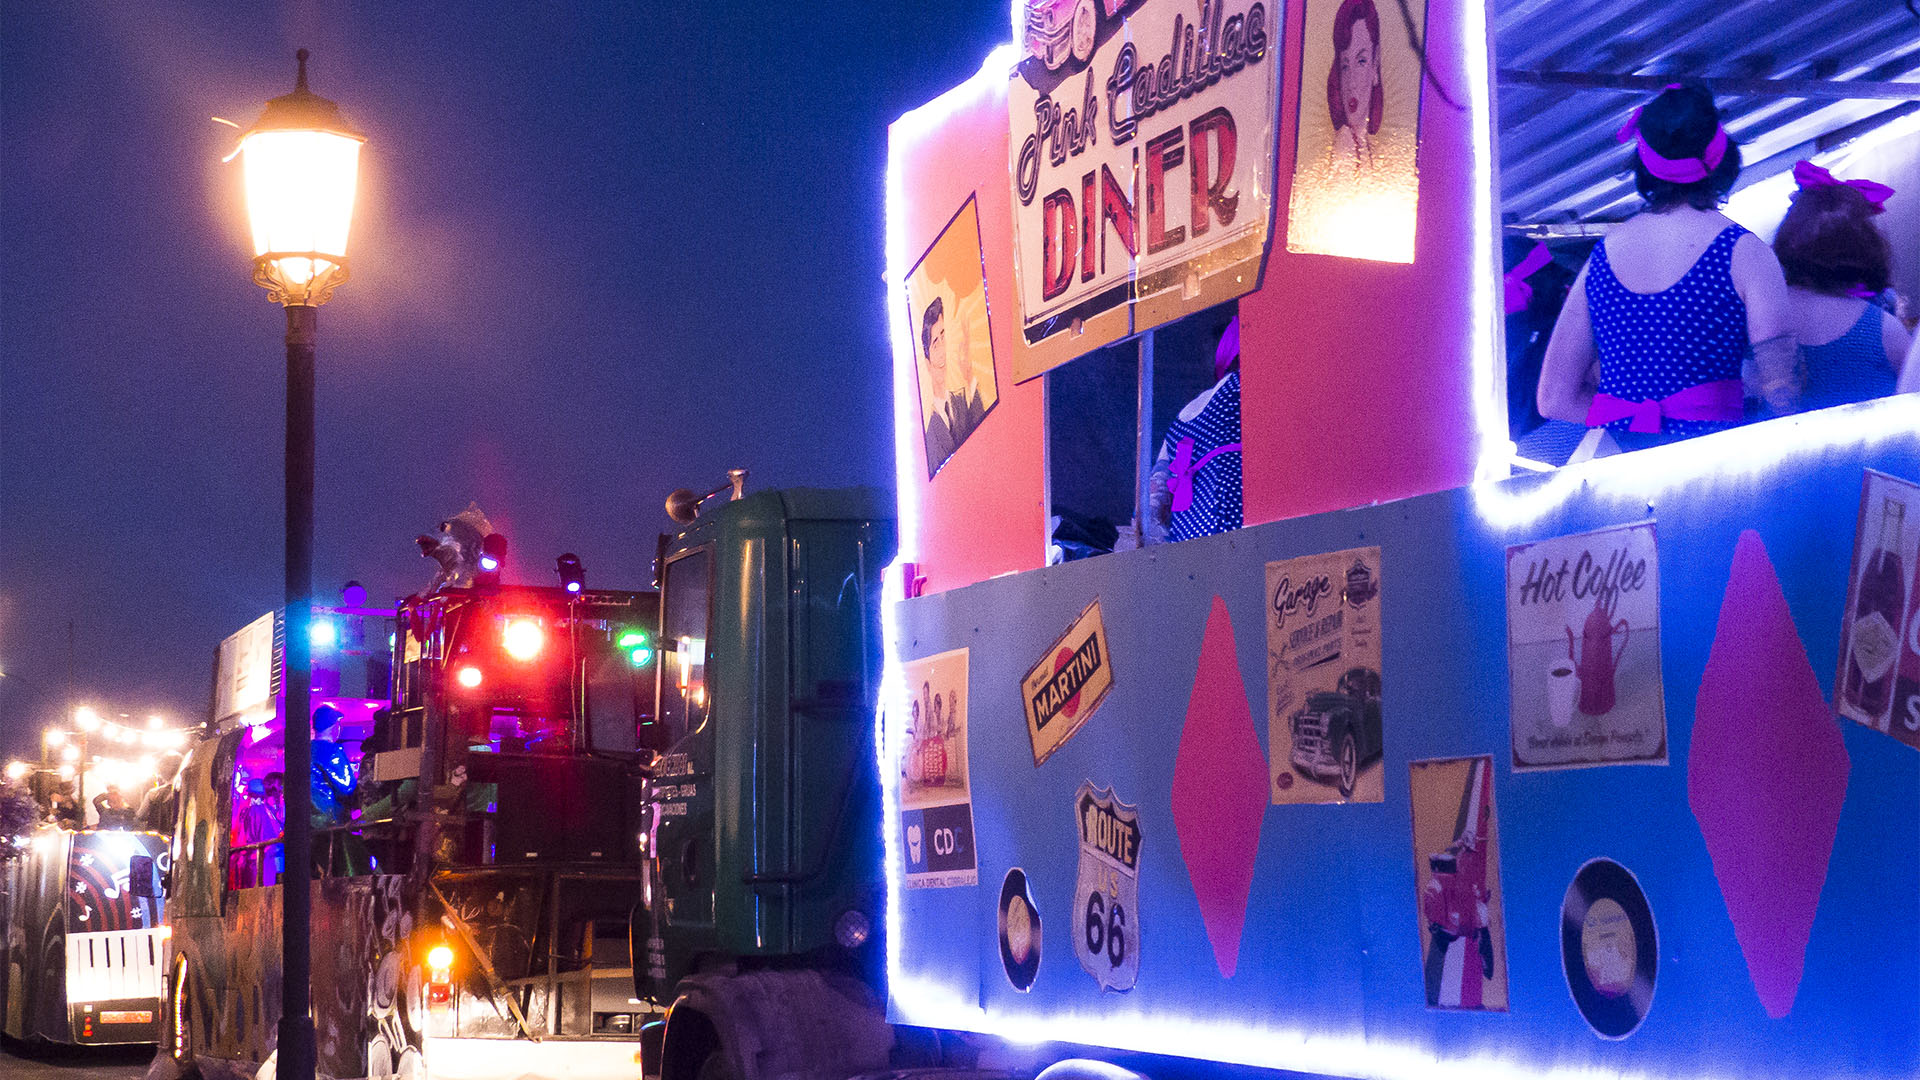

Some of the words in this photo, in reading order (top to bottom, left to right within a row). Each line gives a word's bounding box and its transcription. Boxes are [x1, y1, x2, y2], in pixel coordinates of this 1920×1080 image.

[1016, 66, 1098, 206] Pink
[1106, 0, 1267, 146] Cadillac
[1043, 106, 1240, 302] DINER
[1273, 575, 1332, 626] Garage
[1520, 557, 1570, 606] Hot
[1572, 547, 1647, 621] Coffee
[1035, 640, 1097, 724] MARTINI
[1086, 803, 1133, 865] ROUTE
[1098, 870, 1119, 899] US
[1086, 890, 1126, 968] 66
